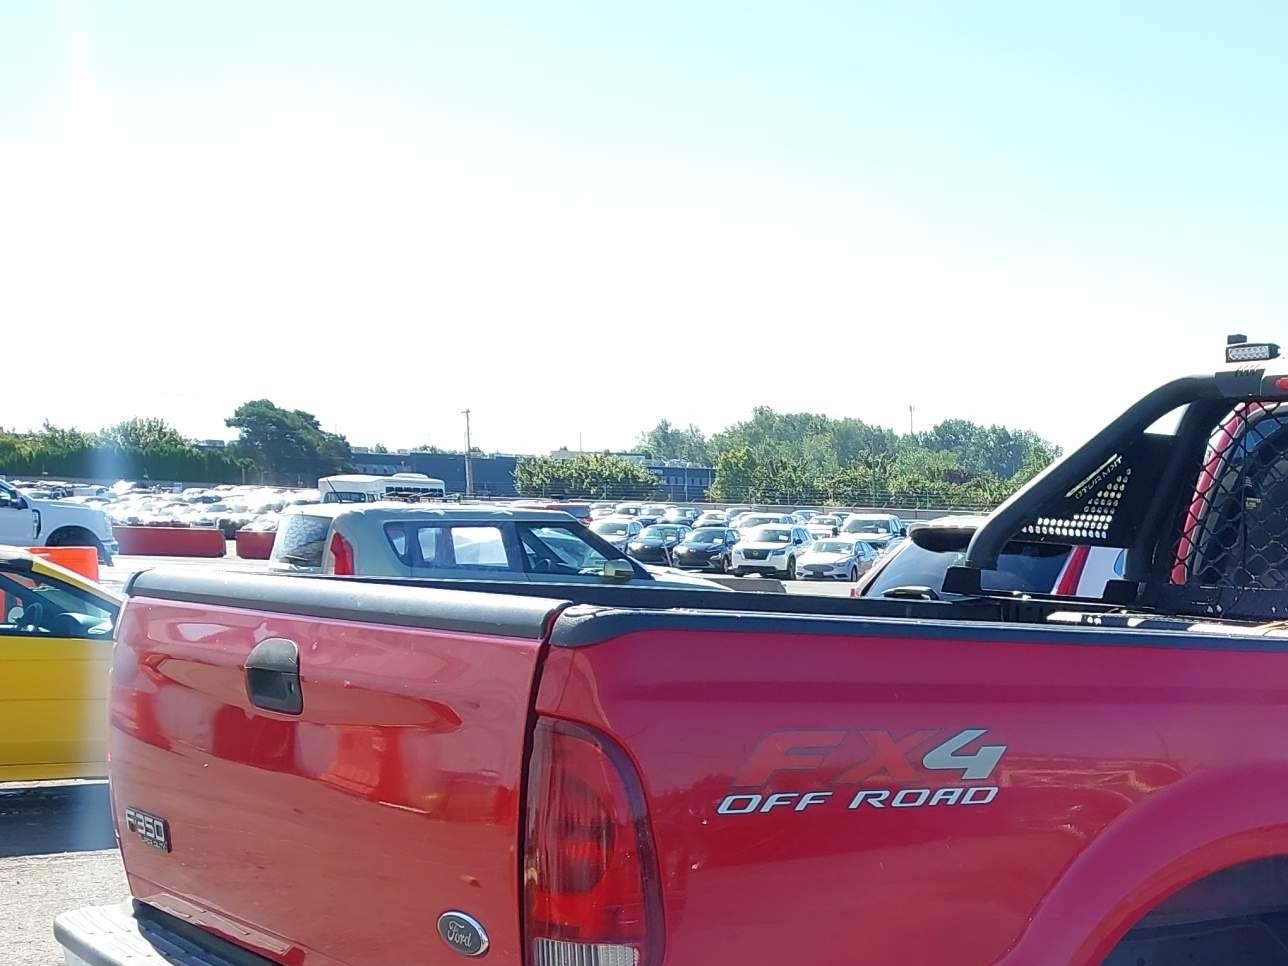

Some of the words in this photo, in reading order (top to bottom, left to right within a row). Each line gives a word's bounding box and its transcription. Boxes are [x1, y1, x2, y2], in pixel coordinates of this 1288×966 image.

[732, 729, 1007, 787] FX4
[717, 791, 833, 815] OFF
[848, 786, 999, 810] ROAD
[447, 920, 472, 947] Ford
